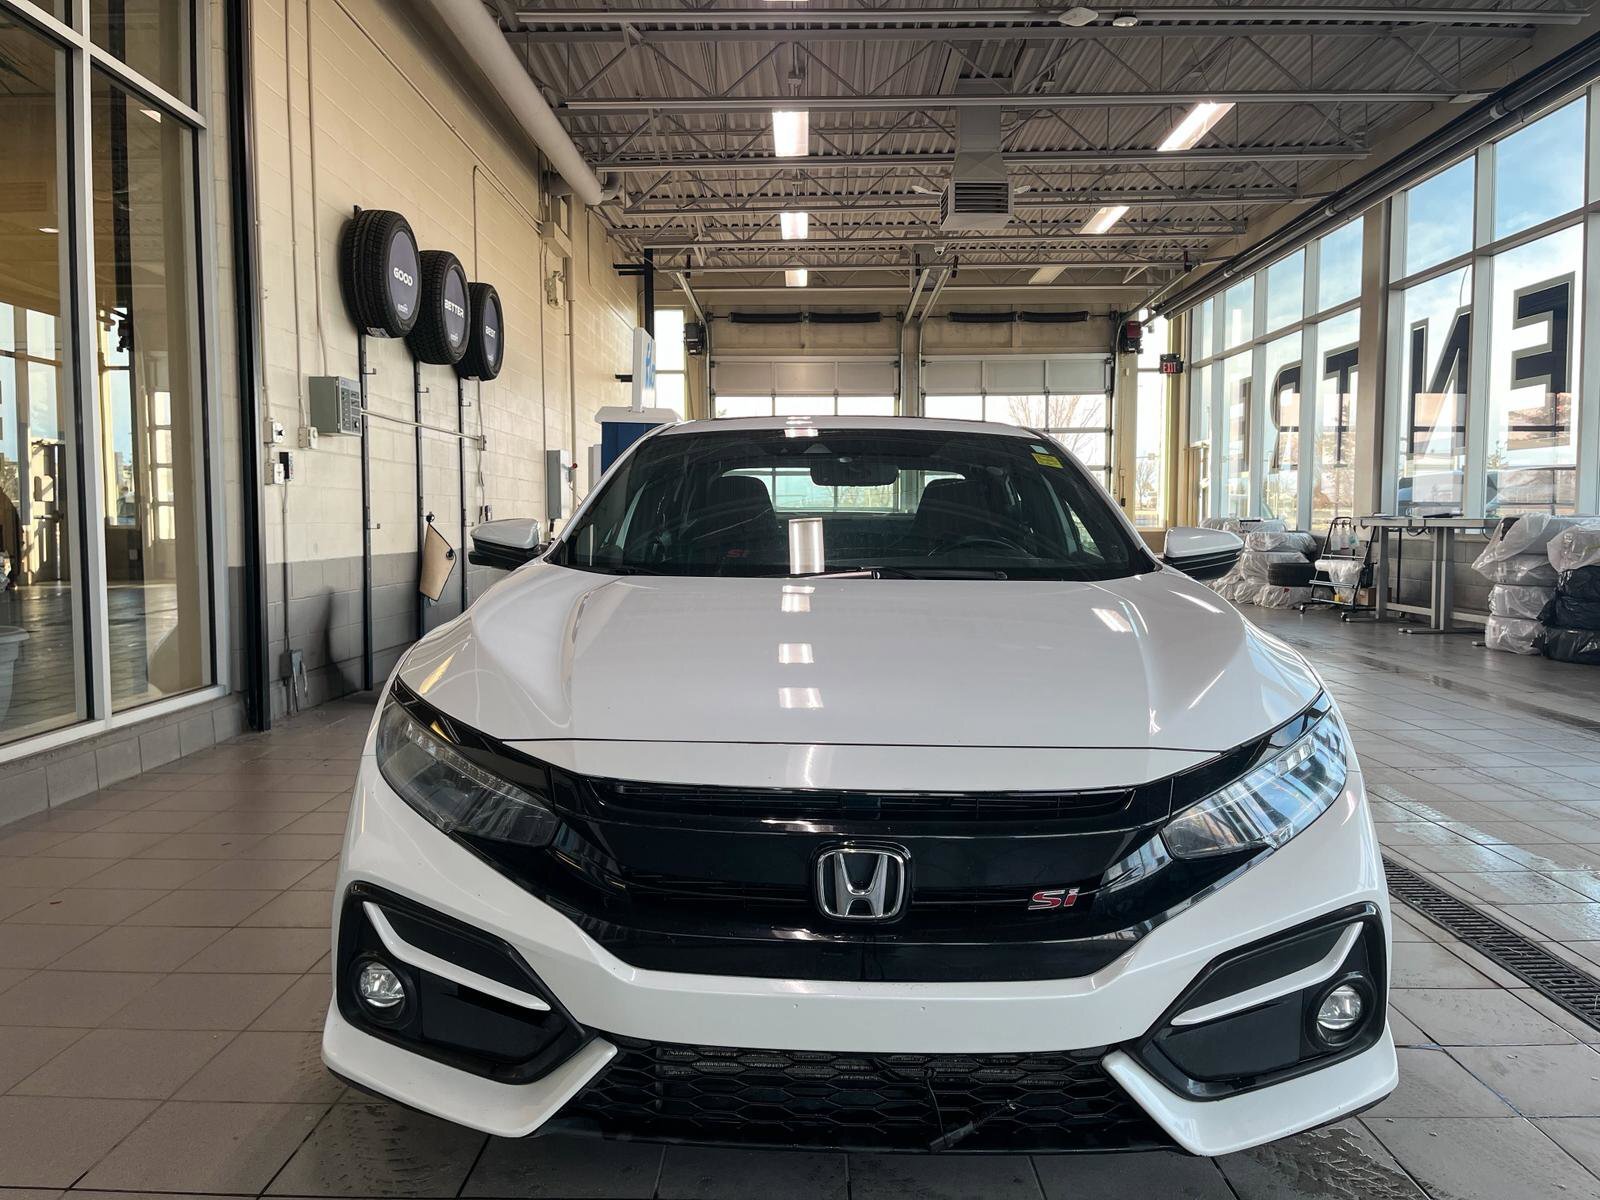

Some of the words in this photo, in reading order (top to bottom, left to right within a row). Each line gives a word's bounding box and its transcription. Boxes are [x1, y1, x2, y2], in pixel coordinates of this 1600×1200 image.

[393, 267, 413, 287] GOOD
[444, 299, 464, 318] BETTER
[1163, 361, 1177, 373] EXIT
[1027, 887, 1080, 911] Si
